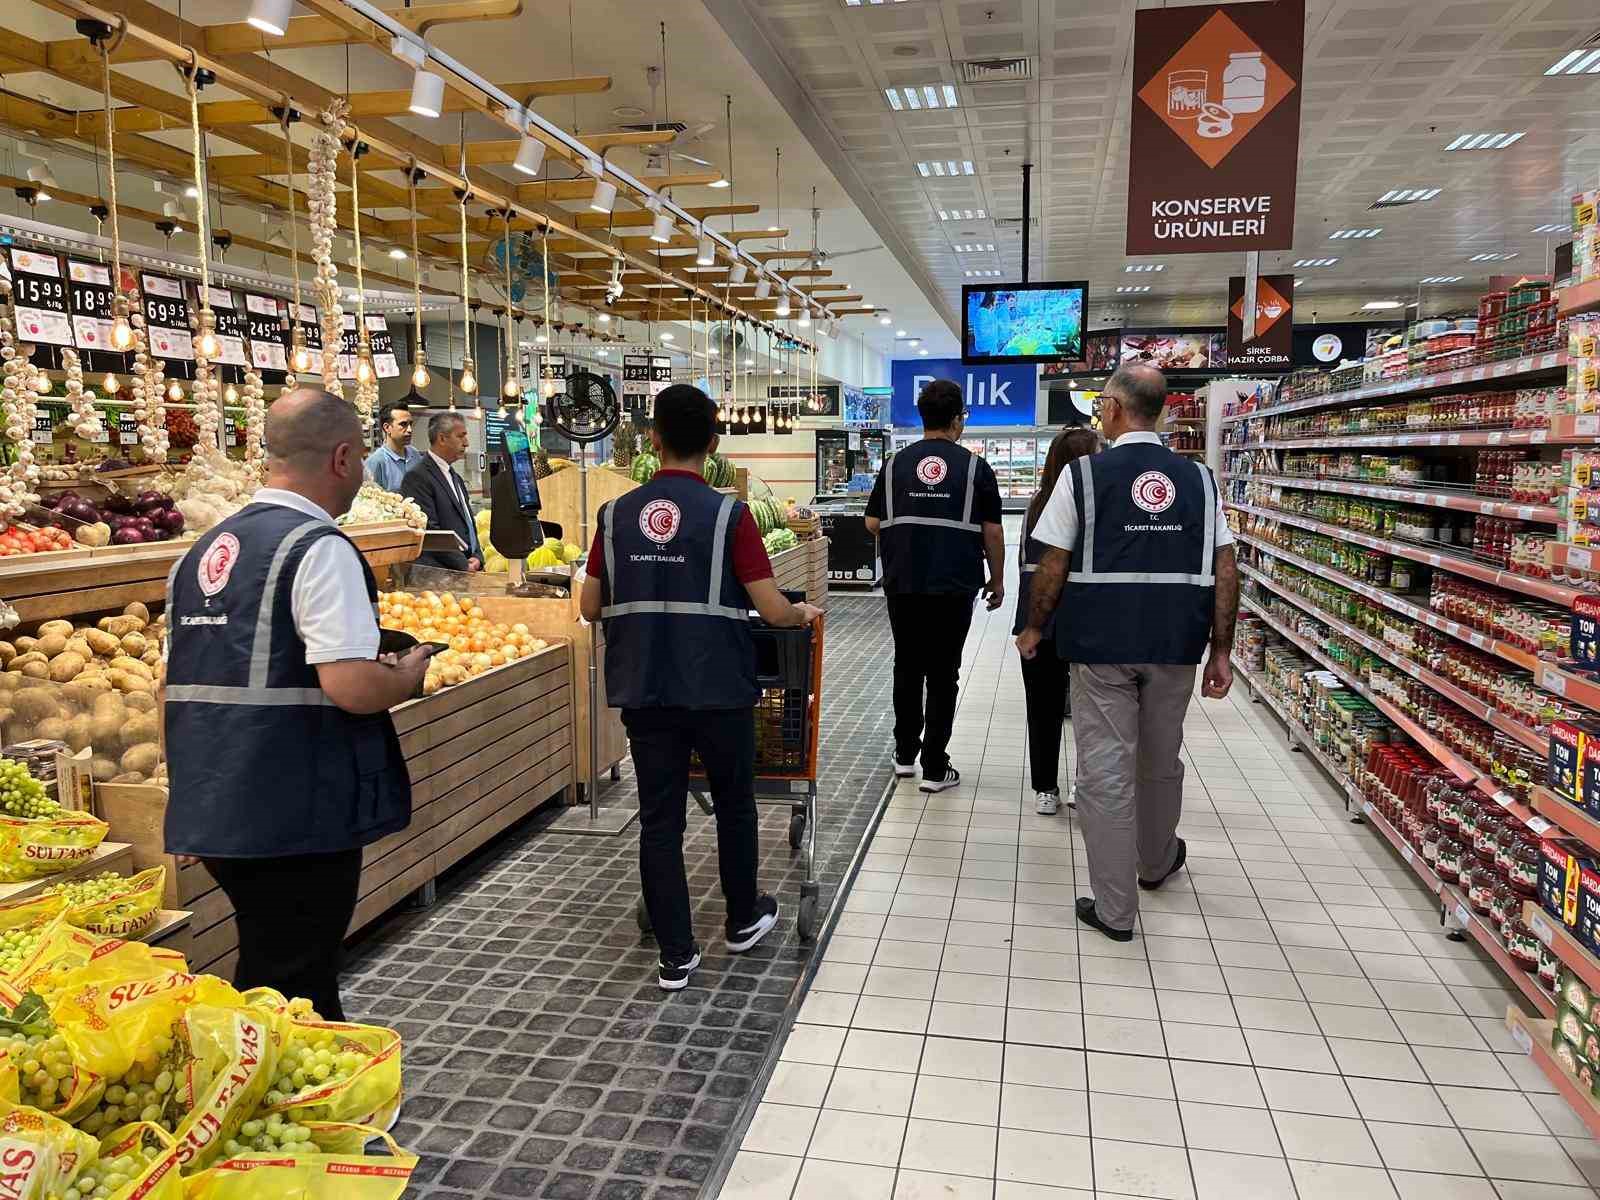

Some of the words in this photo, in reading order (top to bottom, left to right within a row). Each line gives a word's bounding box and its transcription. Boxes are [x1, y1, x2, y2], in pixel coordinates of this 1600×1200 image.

[1152, 196, 1271, 216] KONSERVE
[1154, 215, 1266, 238] ÜRÜNLERİ
[148, 301, 185, 322] 69.95
[1228, 356, 1255, 364] HAZIR
[1257, 355, 1290, 364] ÇORBA
[1246, 346, 1271, 355] SİRKE
